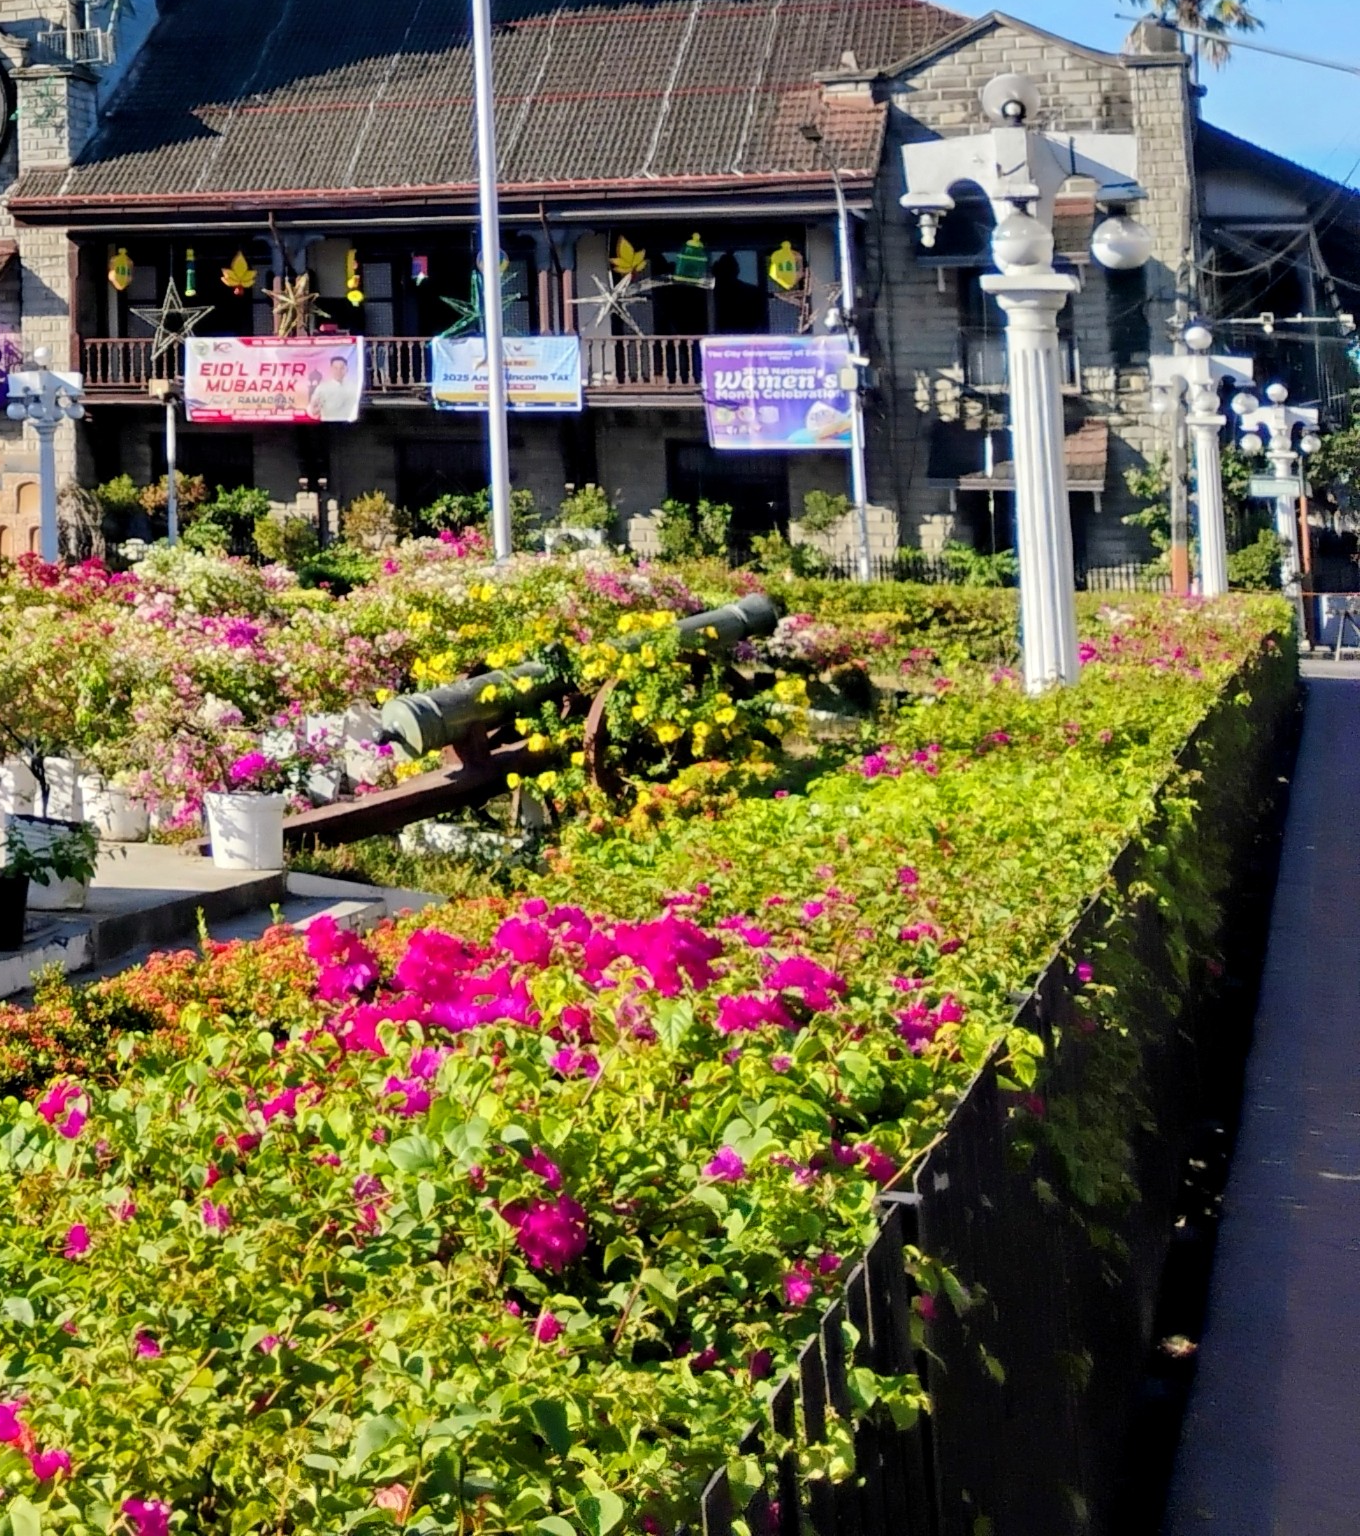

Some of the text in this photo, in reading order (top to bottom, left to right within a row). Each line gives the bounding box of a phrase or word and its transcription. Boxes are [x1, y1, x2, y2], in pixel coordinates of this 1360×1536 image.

[199, 361, 307, 377] EID'L FITR
[442, 373, 469, 382] 2025
[713, 368, 838, 390] Women's
[205, 379, 298, 393] MUBARAK
[715, 389, 845, 401] Month Celebration
